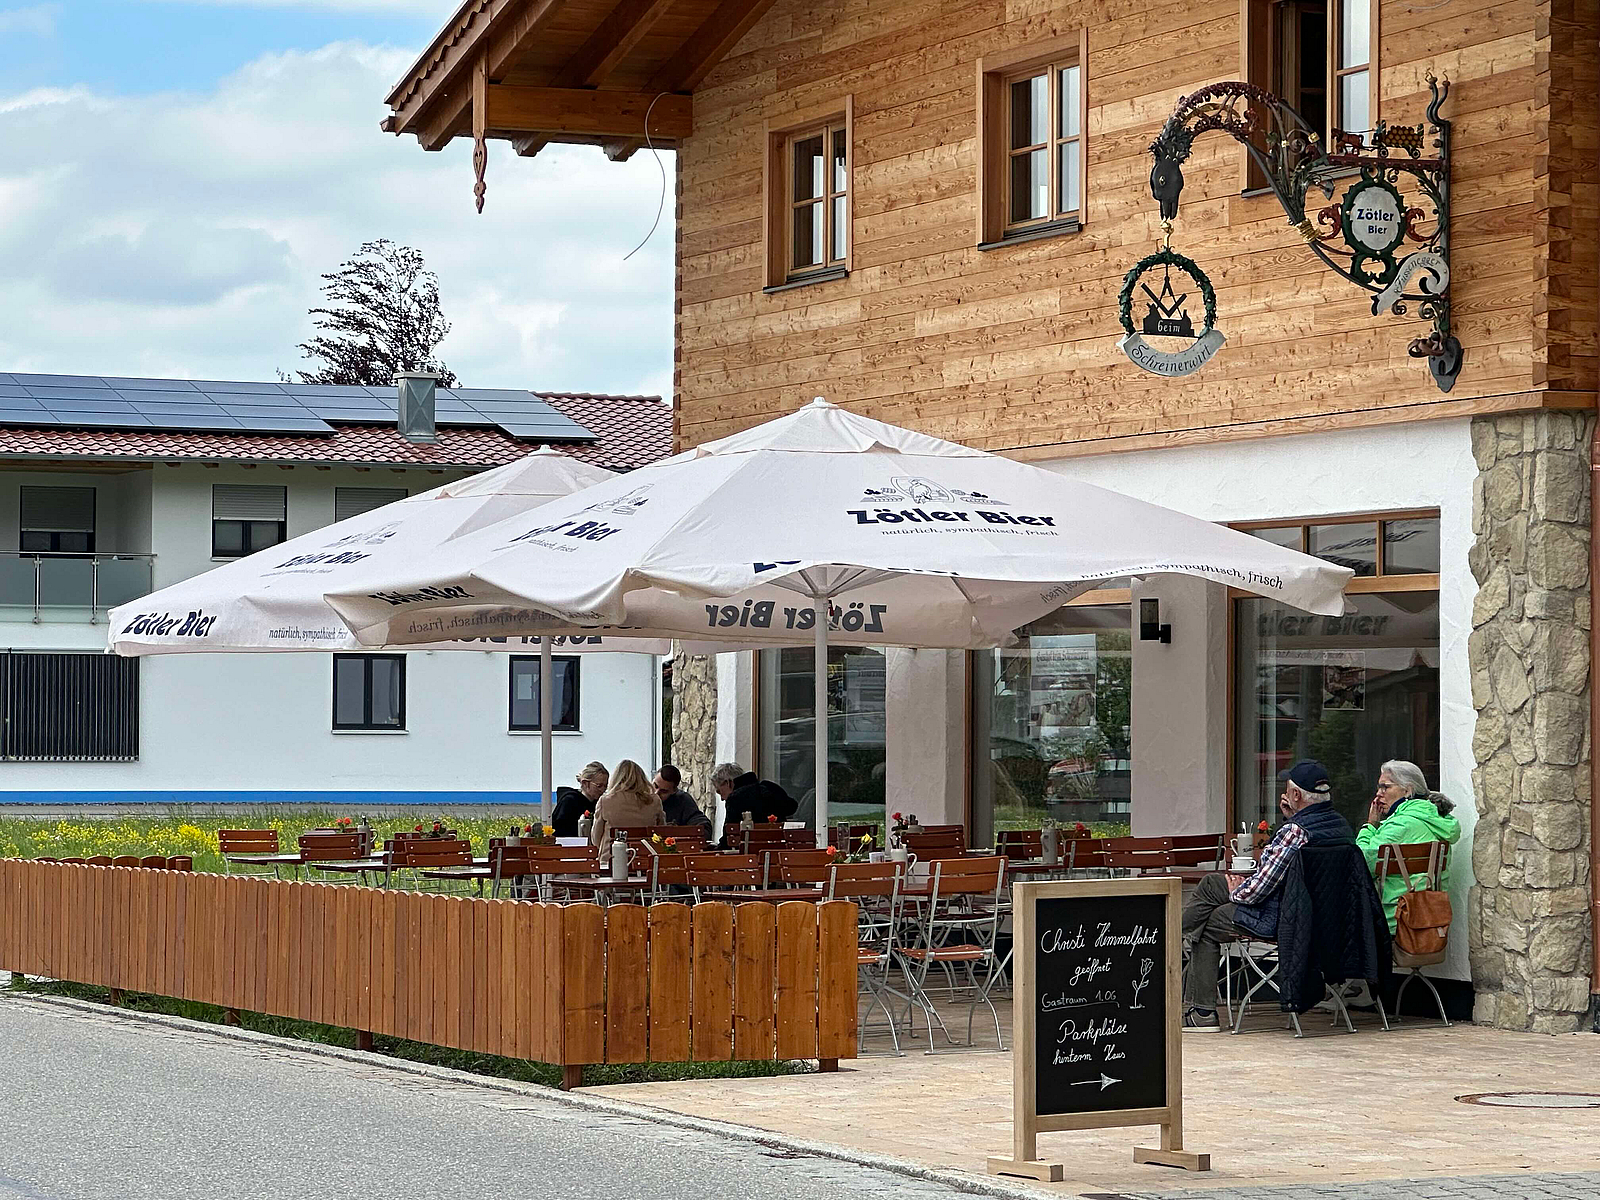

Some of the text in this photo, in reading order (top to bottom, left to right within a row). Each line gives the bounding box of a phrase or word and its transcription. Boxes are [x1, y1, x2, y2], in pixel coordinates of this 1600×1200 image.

[1356, 208, 1395, 222] Zötler
[1367, 225, 1388, 235] Bier
[1157, 319, 1181, 333] beim
[1131, 344, 1212, 373] Schreinerwirt
[846, 507, 1057, 527] Zötler Bier
[563, 520, 622, 541] Bier
[881, 526, 943, 536] natürlich,
[1025, 528, 1060, 537] frisch
[1248, 571, 1285, 590] frisch
[121, 608, 218, 638] Zötler Bier
[1040, 923, 1086, 953] Christi
[1069, 957, 1113, 986] geöffnet
[1041, 991, 1088, 1008] Gastraum
[1056, 1017, 1128, 1046] Parkplätze
